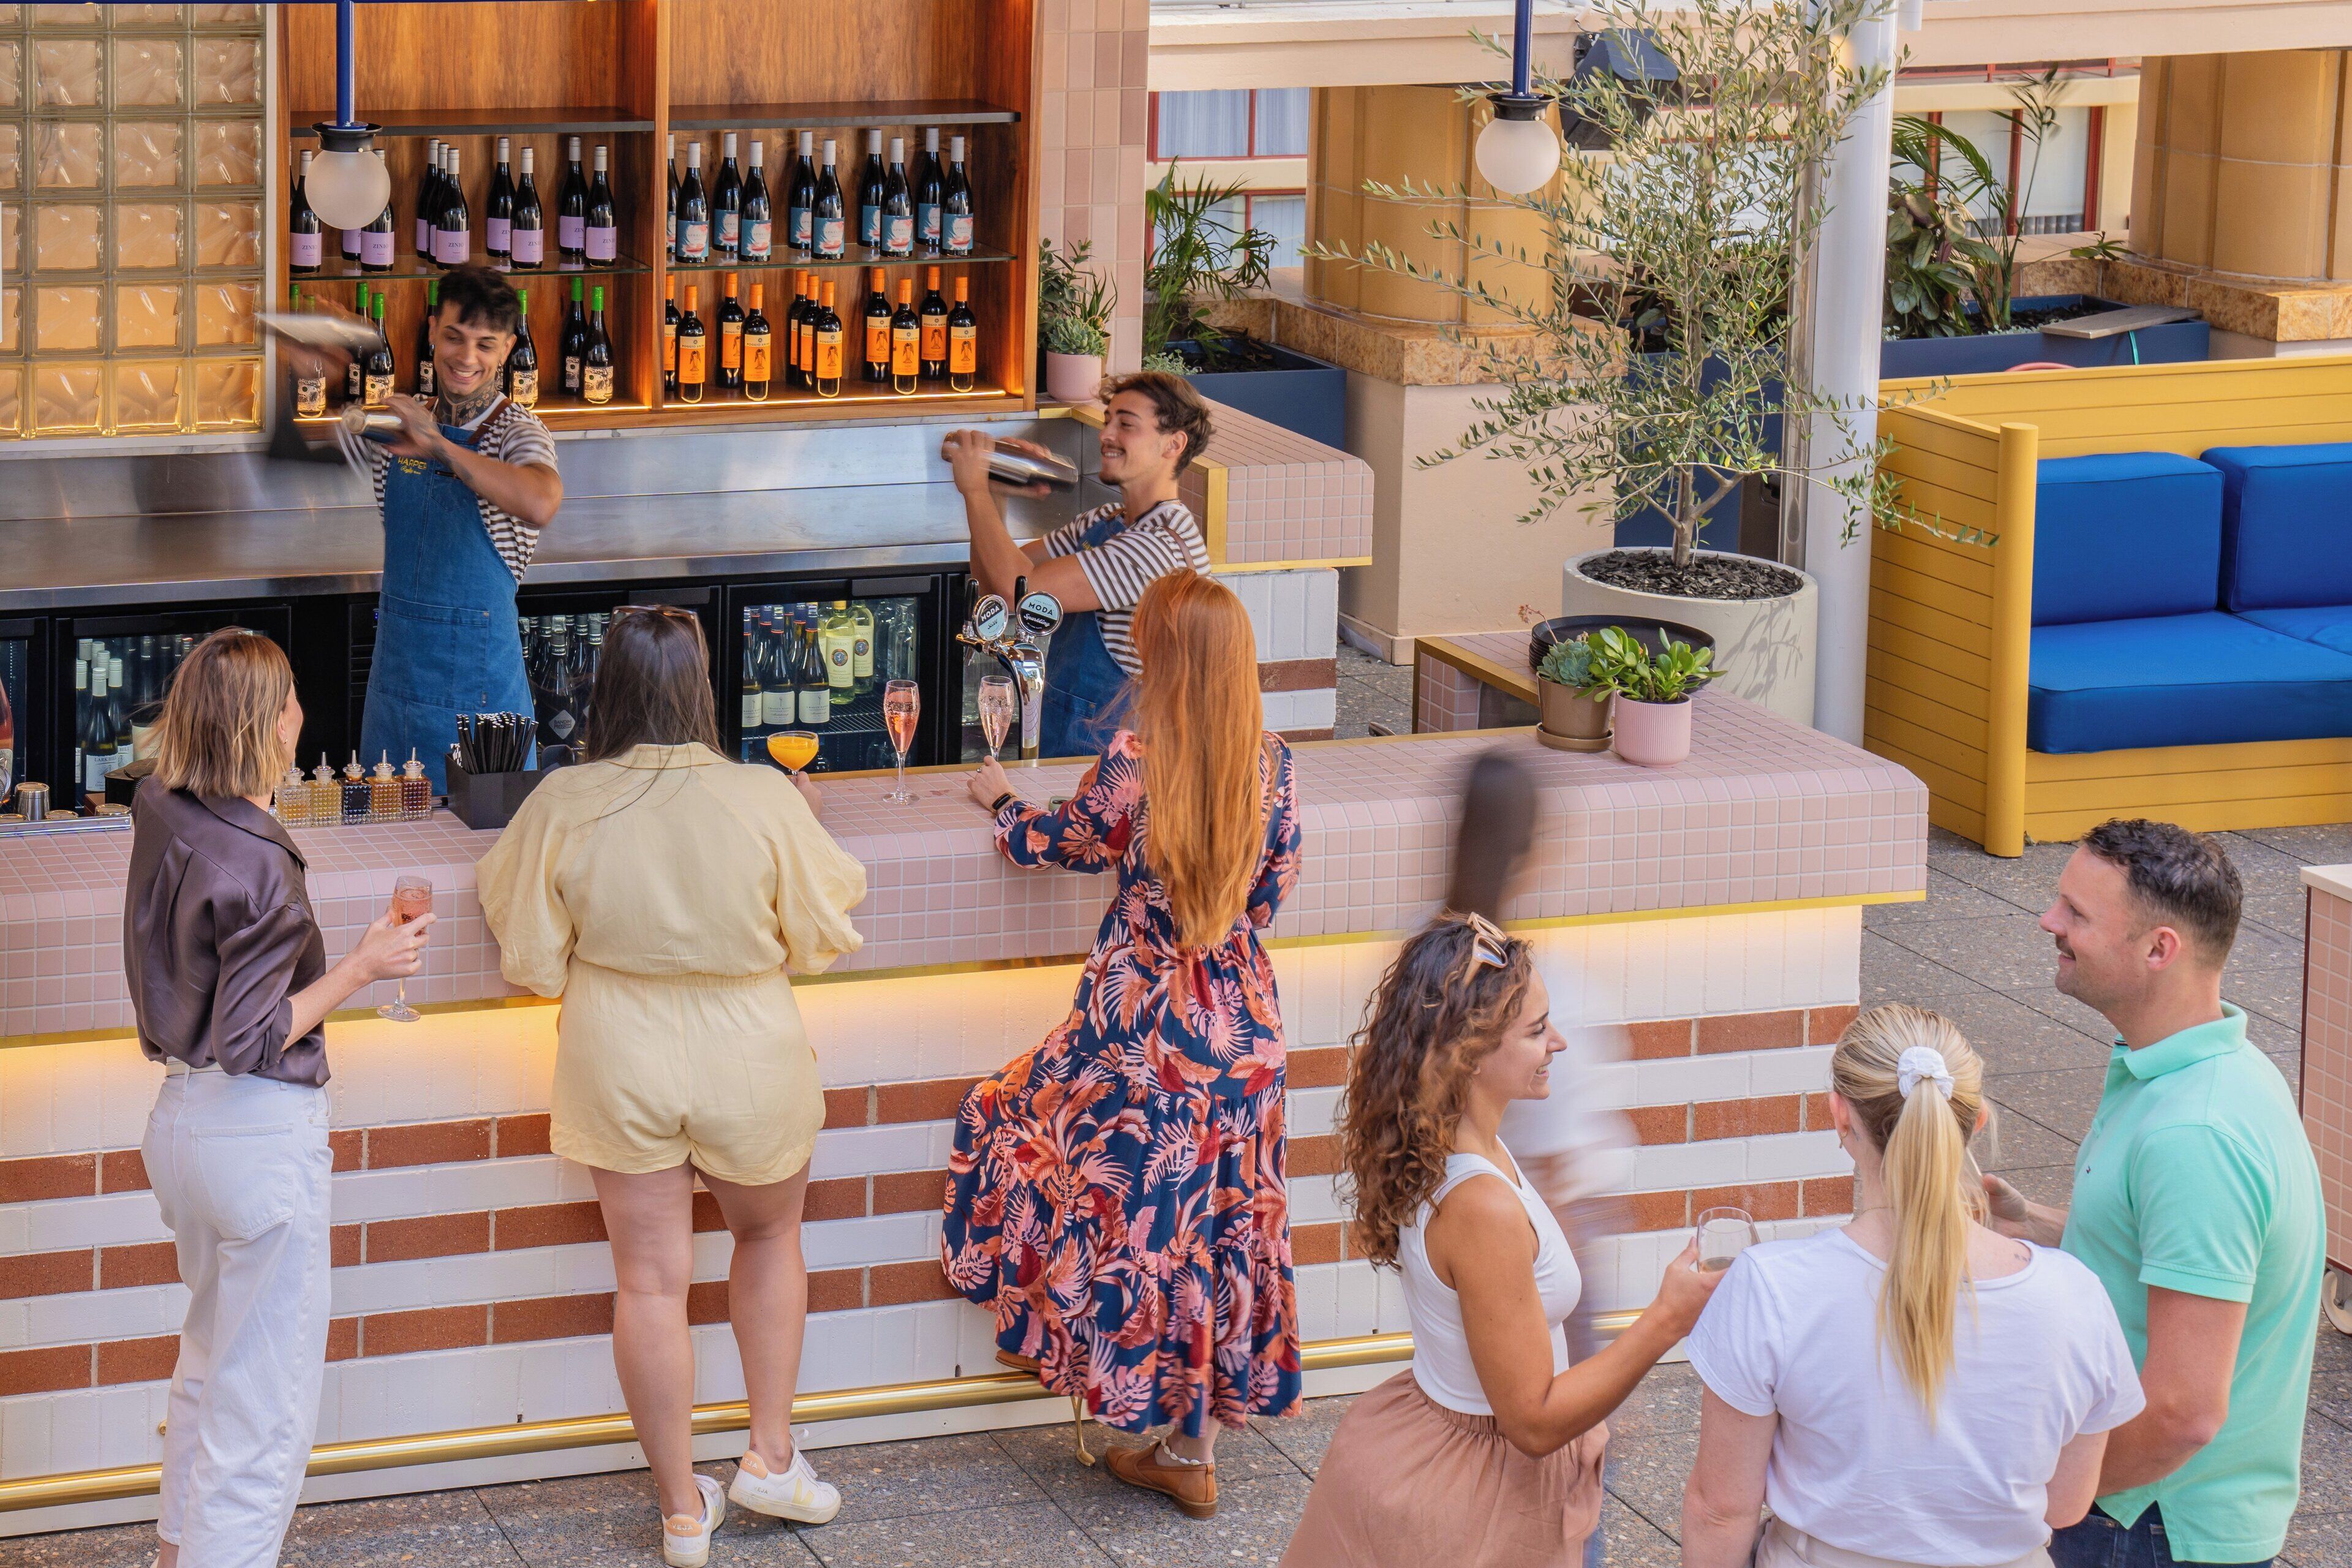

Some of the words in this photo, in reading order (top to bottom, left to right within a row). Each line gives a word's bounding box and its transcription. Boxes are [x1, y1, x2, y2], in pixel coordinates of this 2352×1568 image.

[981, 606, 1000, 622] MODA
[1028, 602, 1053, 616] MODA
[1023, 613, 1050, 627] Sparkling
